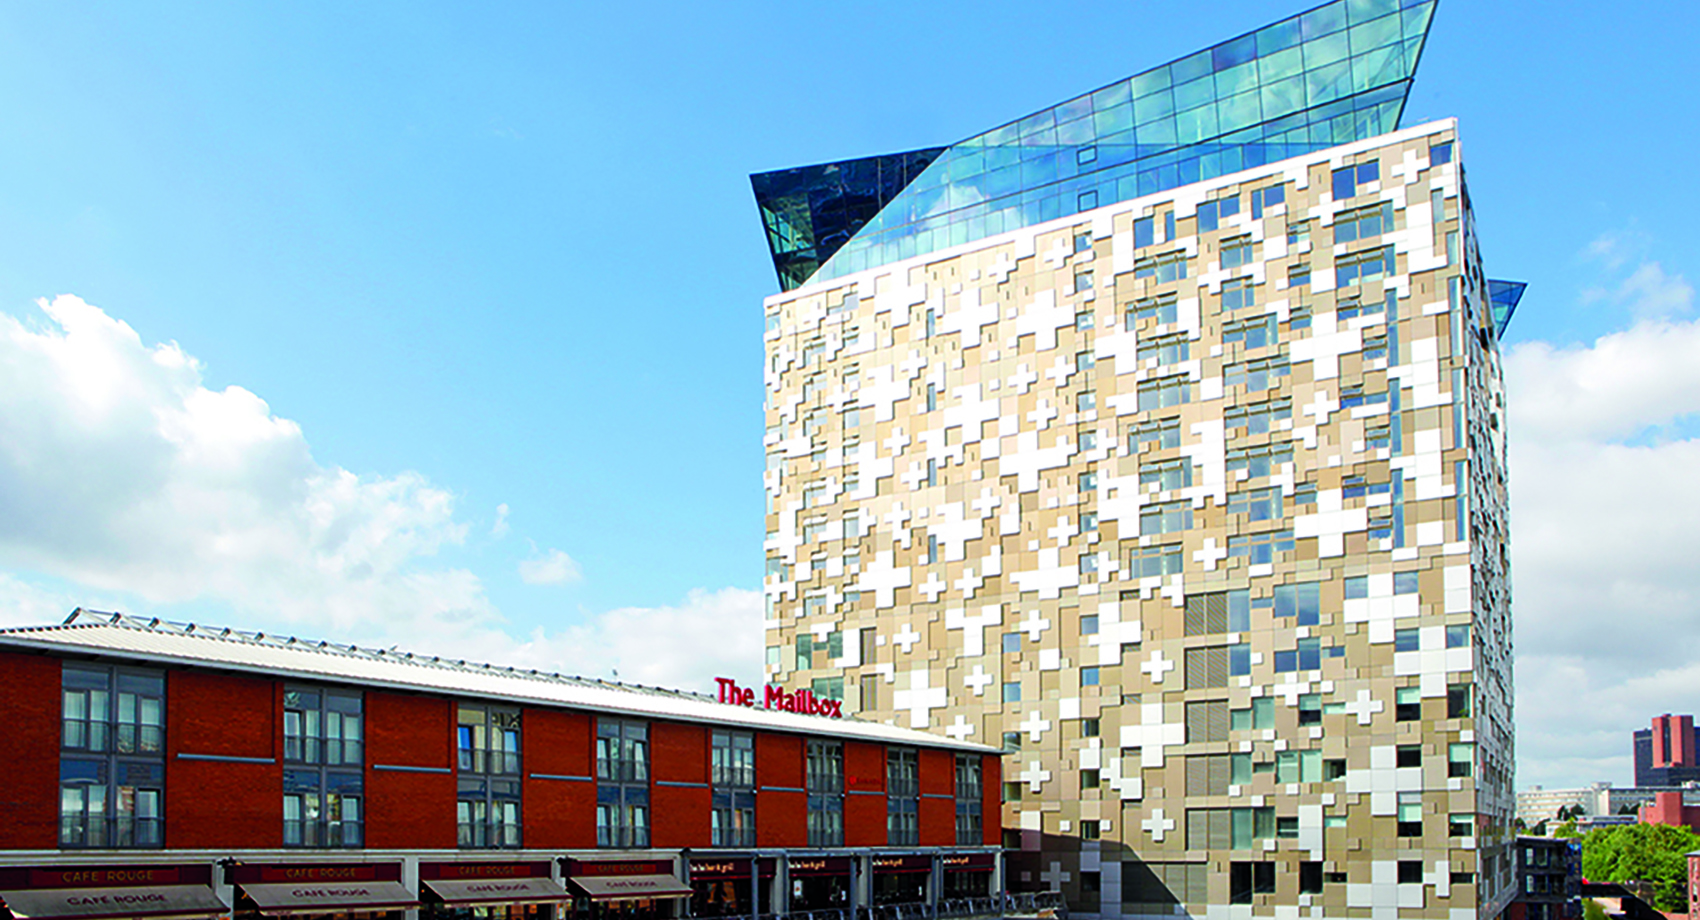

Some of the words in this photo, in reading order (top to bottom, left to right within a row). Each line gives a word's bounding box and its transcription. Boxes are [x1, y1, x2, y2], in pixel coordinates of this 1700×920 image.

[714, 677, 755, 707] The
[764, 684, 842, 718] Mailbox
[106, 869, 154, 881] ROUGE
[319, 867, 356, 877] ROUGE
[113, 893, 166, 904] ROUGE
